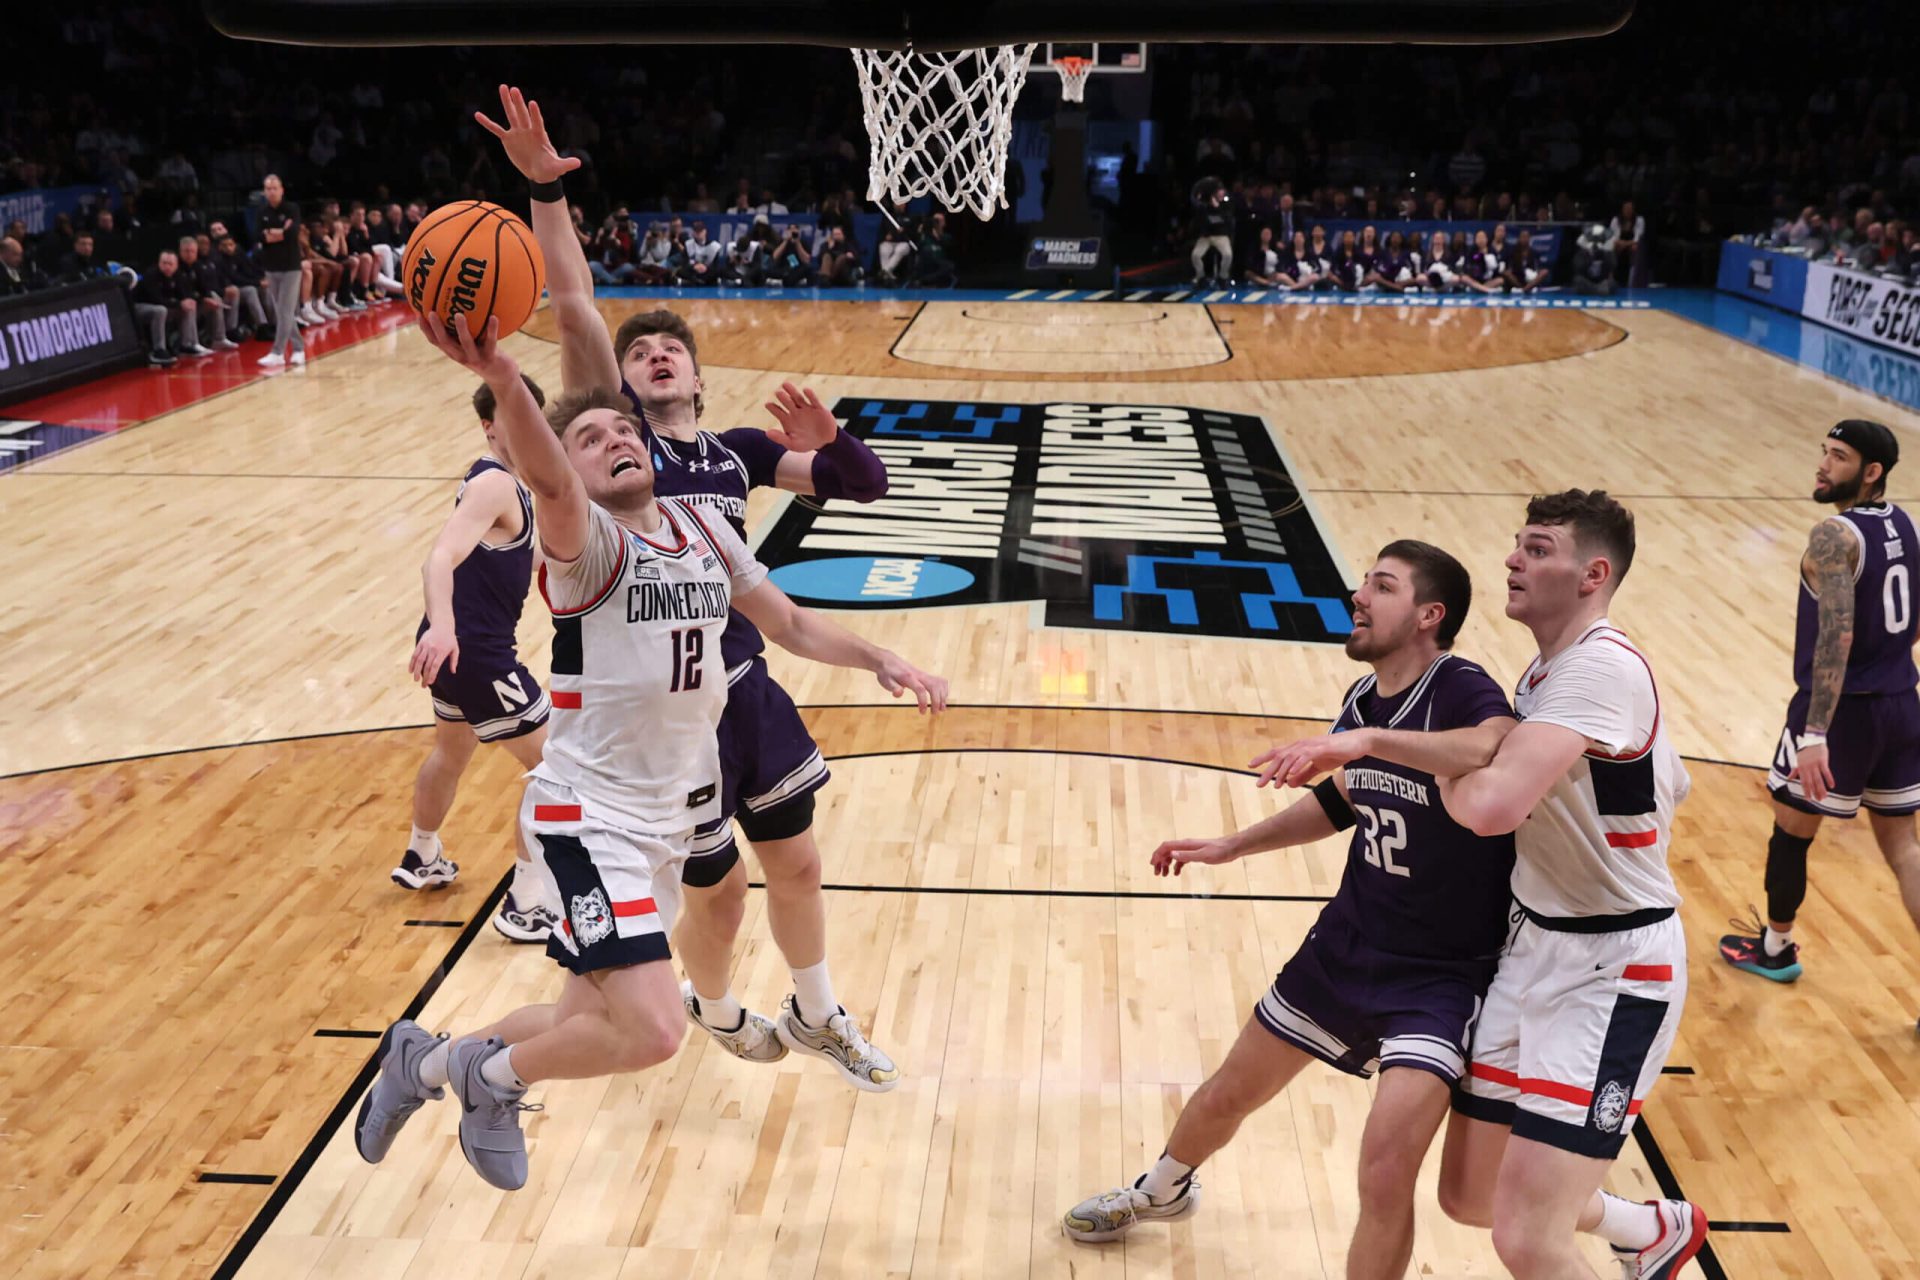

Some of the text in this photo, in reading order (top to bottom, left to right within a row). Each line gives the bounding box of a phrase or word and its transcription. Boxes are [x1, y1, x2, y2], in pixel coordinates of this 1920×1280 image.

[1044, 240, 1081, 252] MARCH
[1047, 252, 1097, 264] MADNESS
[446, 257, 487, 335] Wilso
[7, 303, 113, 365] TOMORROW
[799, 438, 1018, 558] MARCH
[1030, 404, 1227, 544] MADNESS
[861, 559, 924, 597] NCAA
[1883, 564, 1910, 634] 0
[670, 627, 704, 692] 12
[492, 671, 529, 713] N
[1344, 768, 1430, 807] ORTHWESTERN
[1354, 804, 1410, 878] 32
